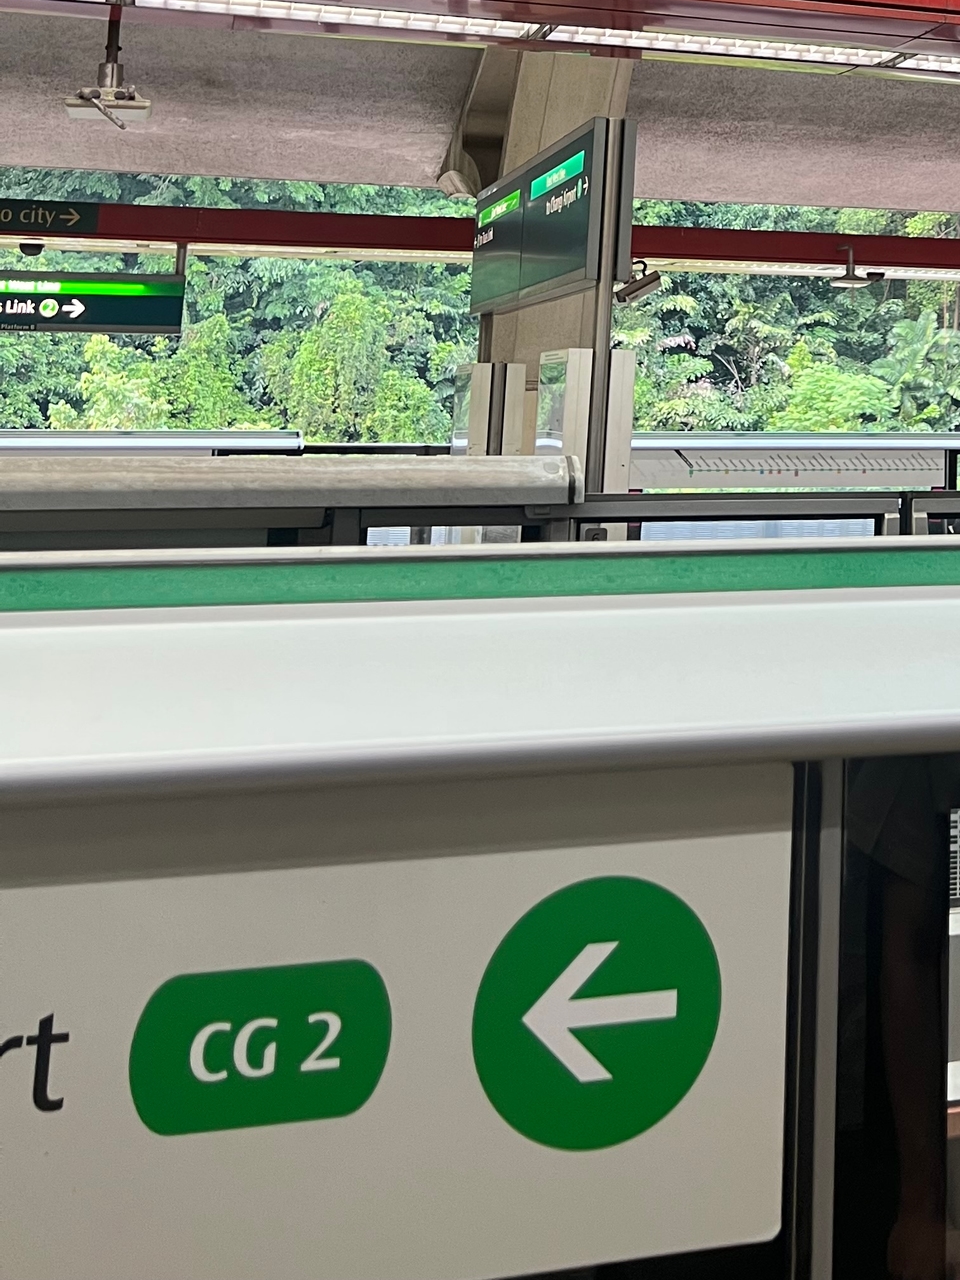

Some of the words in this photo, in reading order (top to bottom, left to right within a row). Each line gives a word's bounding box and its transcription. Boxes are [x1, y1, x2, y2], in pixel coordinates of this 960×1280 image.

[19, 204, 57, 227] city
[5, 298, 36, 314] Link
[189, 1018, 279, 1083] CG
[300, 1010, 342, 1073] 2
